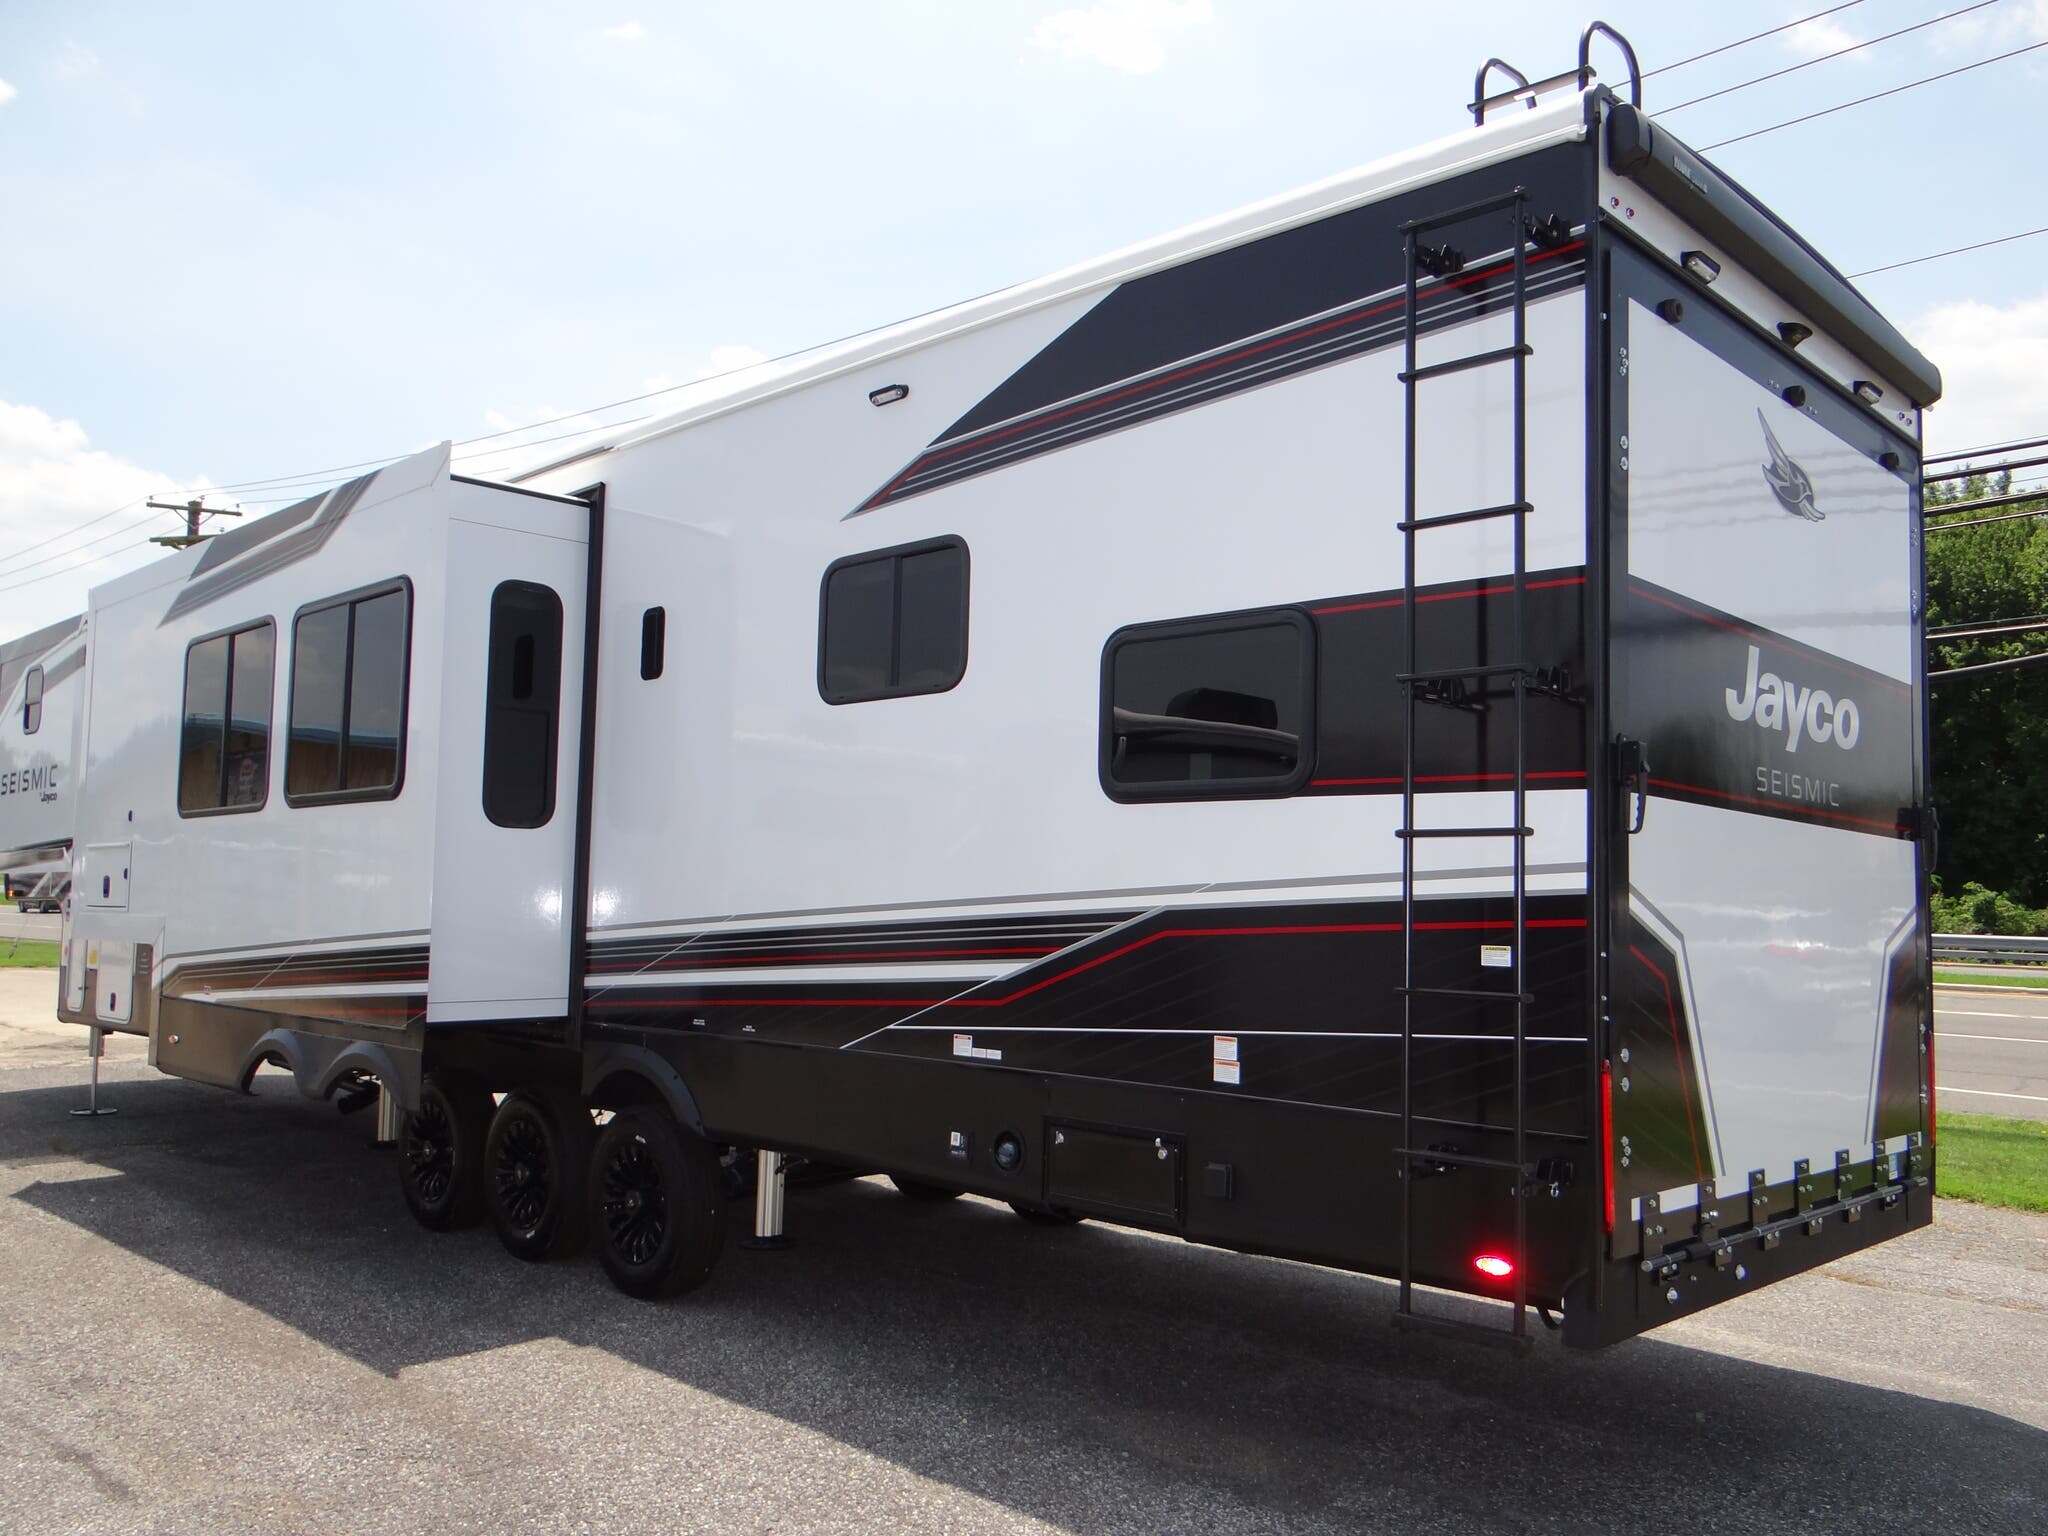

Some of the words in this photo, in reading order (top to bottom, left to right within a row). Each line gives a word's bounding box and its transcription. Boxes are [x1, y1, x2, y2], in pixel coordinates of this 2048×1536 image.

[1725, 645, 1860, 753] Jayco
[1, 765, 58, 795] SEISMIC
[1756, 766, 1841, 807] SEISMIC
